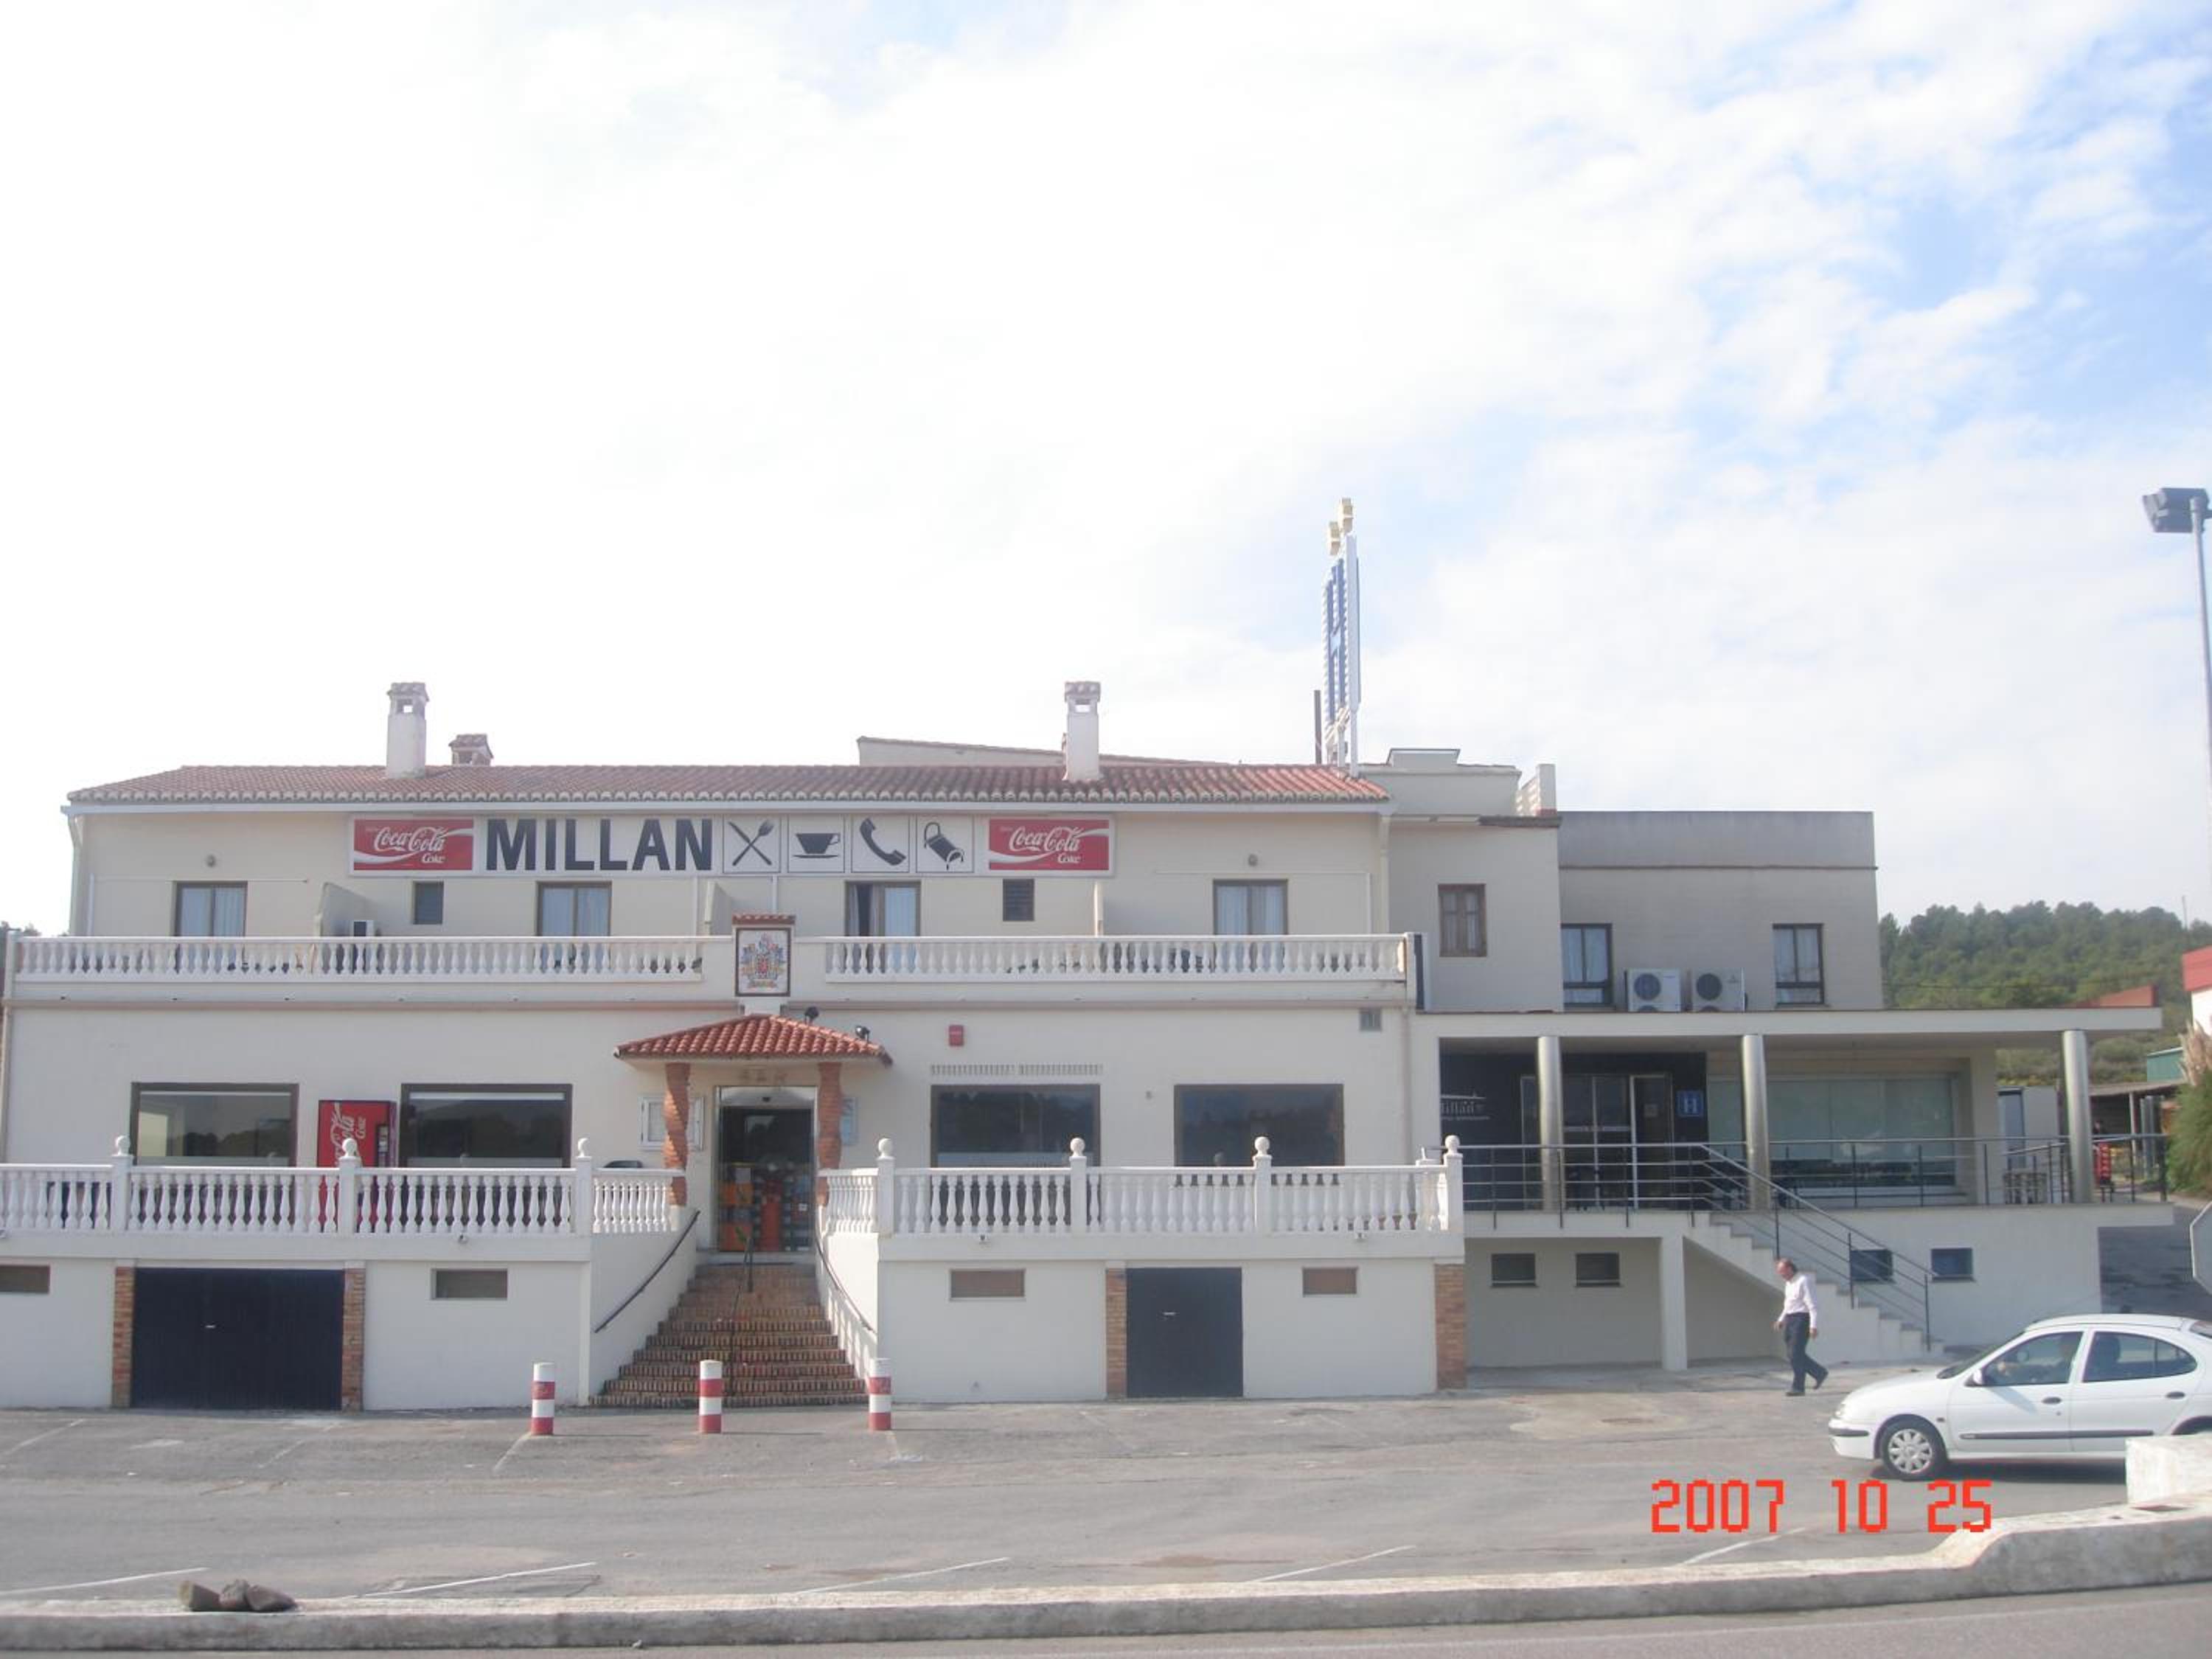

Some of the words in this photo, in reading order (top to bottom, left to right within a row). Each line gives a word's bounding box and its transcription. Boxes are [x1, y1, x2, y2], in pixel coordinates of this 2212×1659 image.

[374, 827, 447, 852] Coca-Cola
[487, 819, 712, 870] MILLAN
[1009, 827, 1082, 852] Coca-Cola
